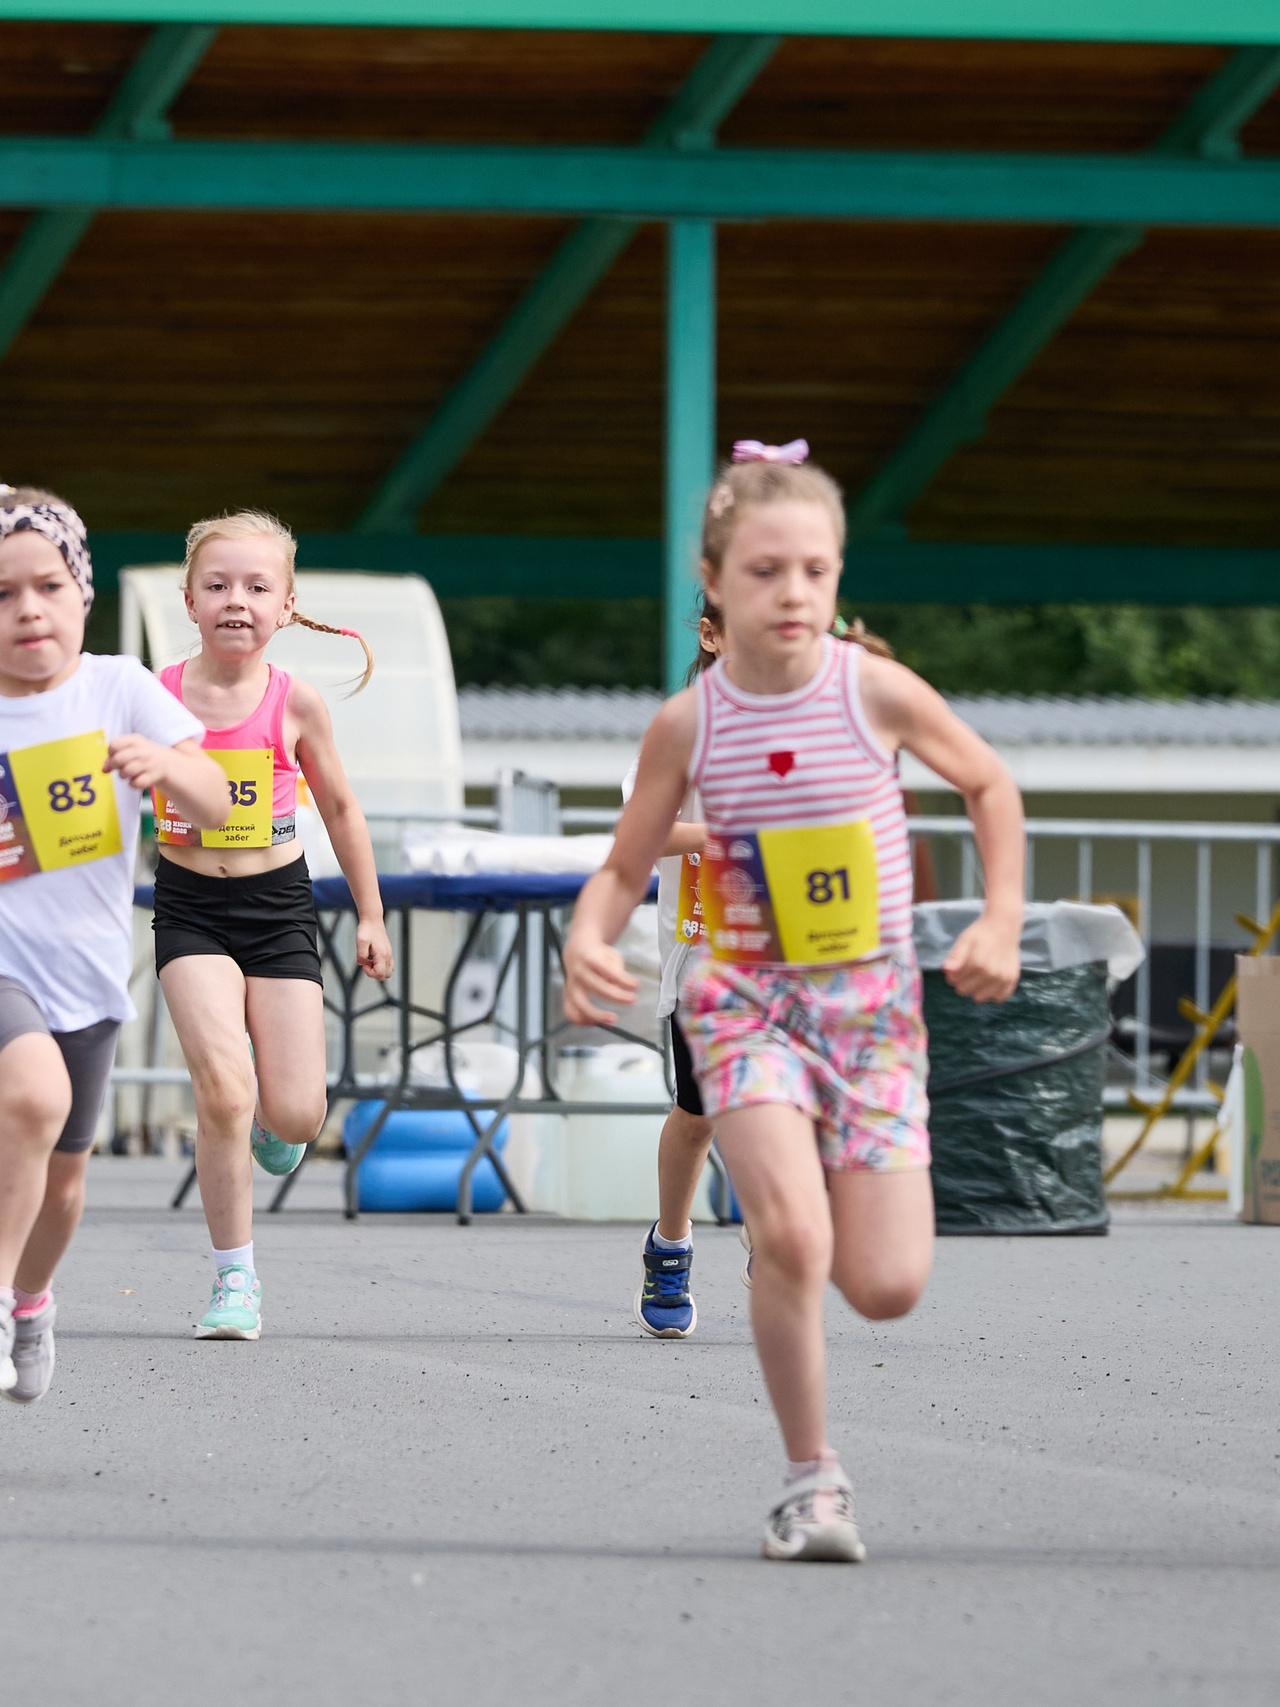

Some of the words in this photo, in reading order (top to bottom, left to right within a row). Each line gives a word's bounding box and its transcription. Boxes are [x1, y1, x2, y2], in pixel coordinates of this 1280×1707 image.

[48, 774, 97, 813] 83
[159, 818, 172, 833] 28
[224, 833, 250, 842] забег
[807, 867, 851, 904] 81
